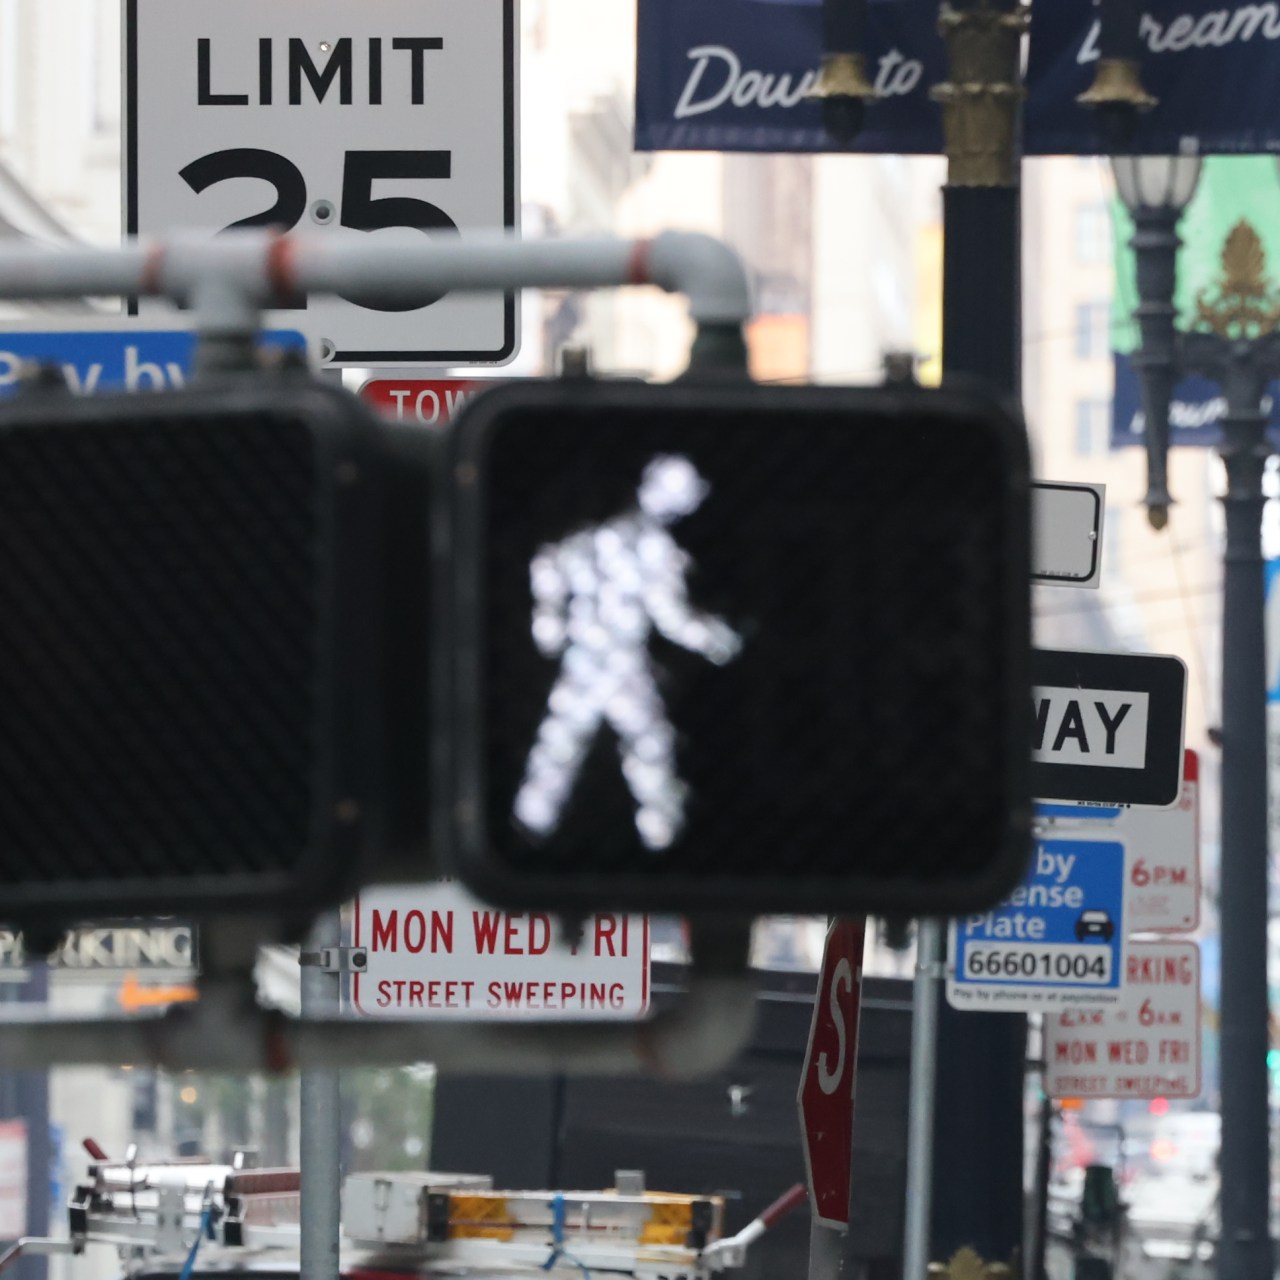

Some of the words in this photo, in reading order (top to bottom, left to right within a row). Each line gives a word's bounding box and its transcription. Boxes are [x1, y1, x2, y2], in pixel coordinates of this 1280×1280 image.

[197, 37, 444, 106] LIMIT
[674, 45, 826, 119] Dow
[875, 48, 922, 98] to
[178, 147, 462, 312] 25
[1037, 845, 1077, 884] by
[1009, 884, 1084, 908] ense
[372, 909, 453, 953] MON
[472, 911, 551, 955] WED
[570, 912, 628, 957] RI
[965, 911, 1047, 940] Plate
[968, 951, 1106, 979] 66601004
[1126, 955, 1192, 985] RKING
[376, 980, 474, 1008] STREET
[487, 981, 624, 1011] SWEEPING
[1158, 1040, 1190, 1064] FRI
